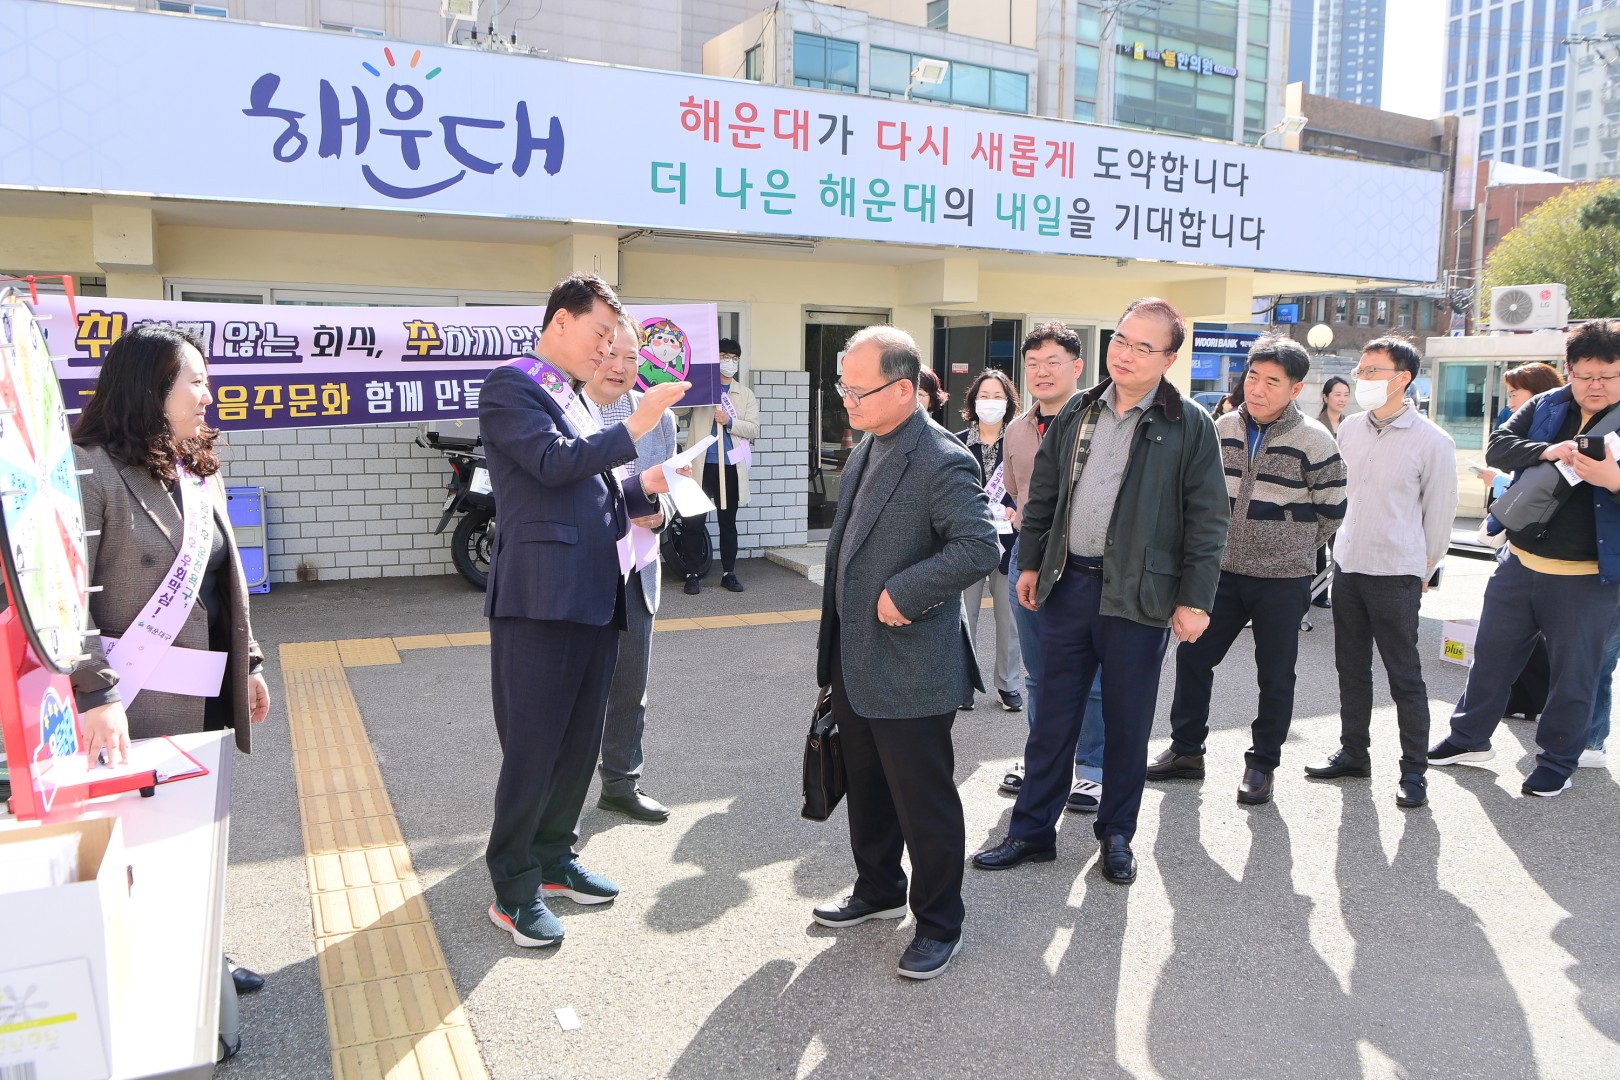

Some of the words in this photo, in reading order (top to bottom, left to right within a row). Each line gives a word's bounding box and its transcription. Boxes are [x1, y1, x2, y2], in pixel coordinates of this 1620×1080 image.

[242, 73, 565, 178] 해운대
[680, 96, 853, 155] 해운대가
[877, 120, 948, 165] 다시
[971, 133, 1074, 178] 새롭게
[1094, 147, 1248, 197] 도약합니다
[651, 162, 687, 204] 더
[715, 167, 796, 215] 나은
[820, 174, 973, 226] 해운대의
[997, 193, 1095, 239] 내일을
[1116, 205, 1265, 250] 기대합니다
[223, 321, 299, 357] 않는
[310, 325, 383, 358] 회식,
[403, 320, 503, 356] 추하지
[506, 326, 543, 355] 않
[1195, 338, 1219, 348] WOORI
[1218, 338, 1238, 348] BANK
[216, 382, 351, 420] 음주문화
[365, 380, 424, 414] 함께
[152, 554, 192, 618] 후회막심!
[1444, 644, 1463, 656] plus
